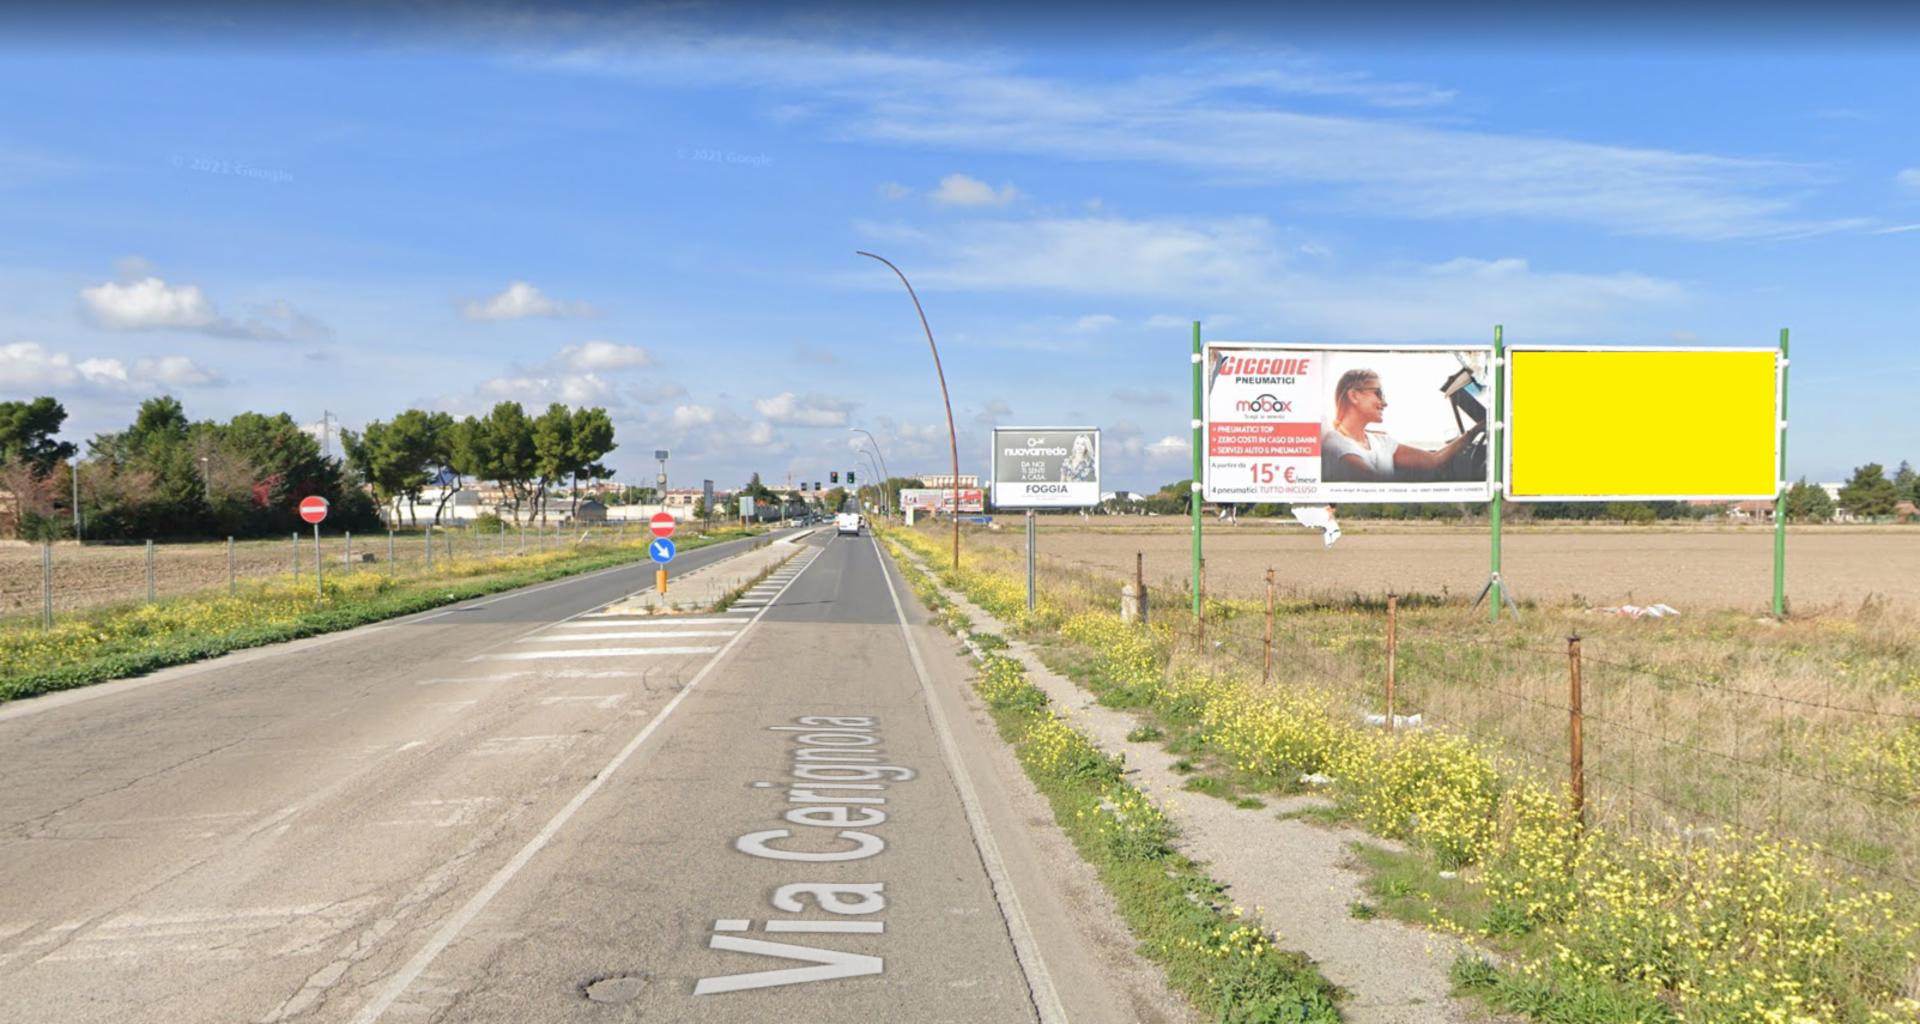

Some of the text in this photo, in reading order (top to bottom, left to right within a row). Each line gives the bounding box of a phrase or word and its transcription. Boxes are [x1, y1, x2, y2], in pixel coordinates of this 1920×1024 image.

[1219, 356, 1310, 376] CICCONE
[1235, 376, 1295, 385] PNEUMATICI
[1236, 396, 1292, 412] mobox
[1217, 425, 1275, 433] PNEUMATICI TOP
[1217, 435, 1237, 444] ZERO
[1237, 435, 1258, 444] COSTI
[1267, 435, 1287, 444] CASO
[1004, 447, 1067, 456] nuovarredo
[1217, 446, 1244, 455] SERVIZI
[1244, 446, 1264, 455] AUTO
[1270, 446, 1312, 455] PNEUMATICI
[1025, 484, 1068, 494] FOGGIA
[1217, 486, 1258, 495] pneumatici
[1260, 486, 1285, 494] TUTTO
[1286, 486, 1317, 494] INCLUSO
